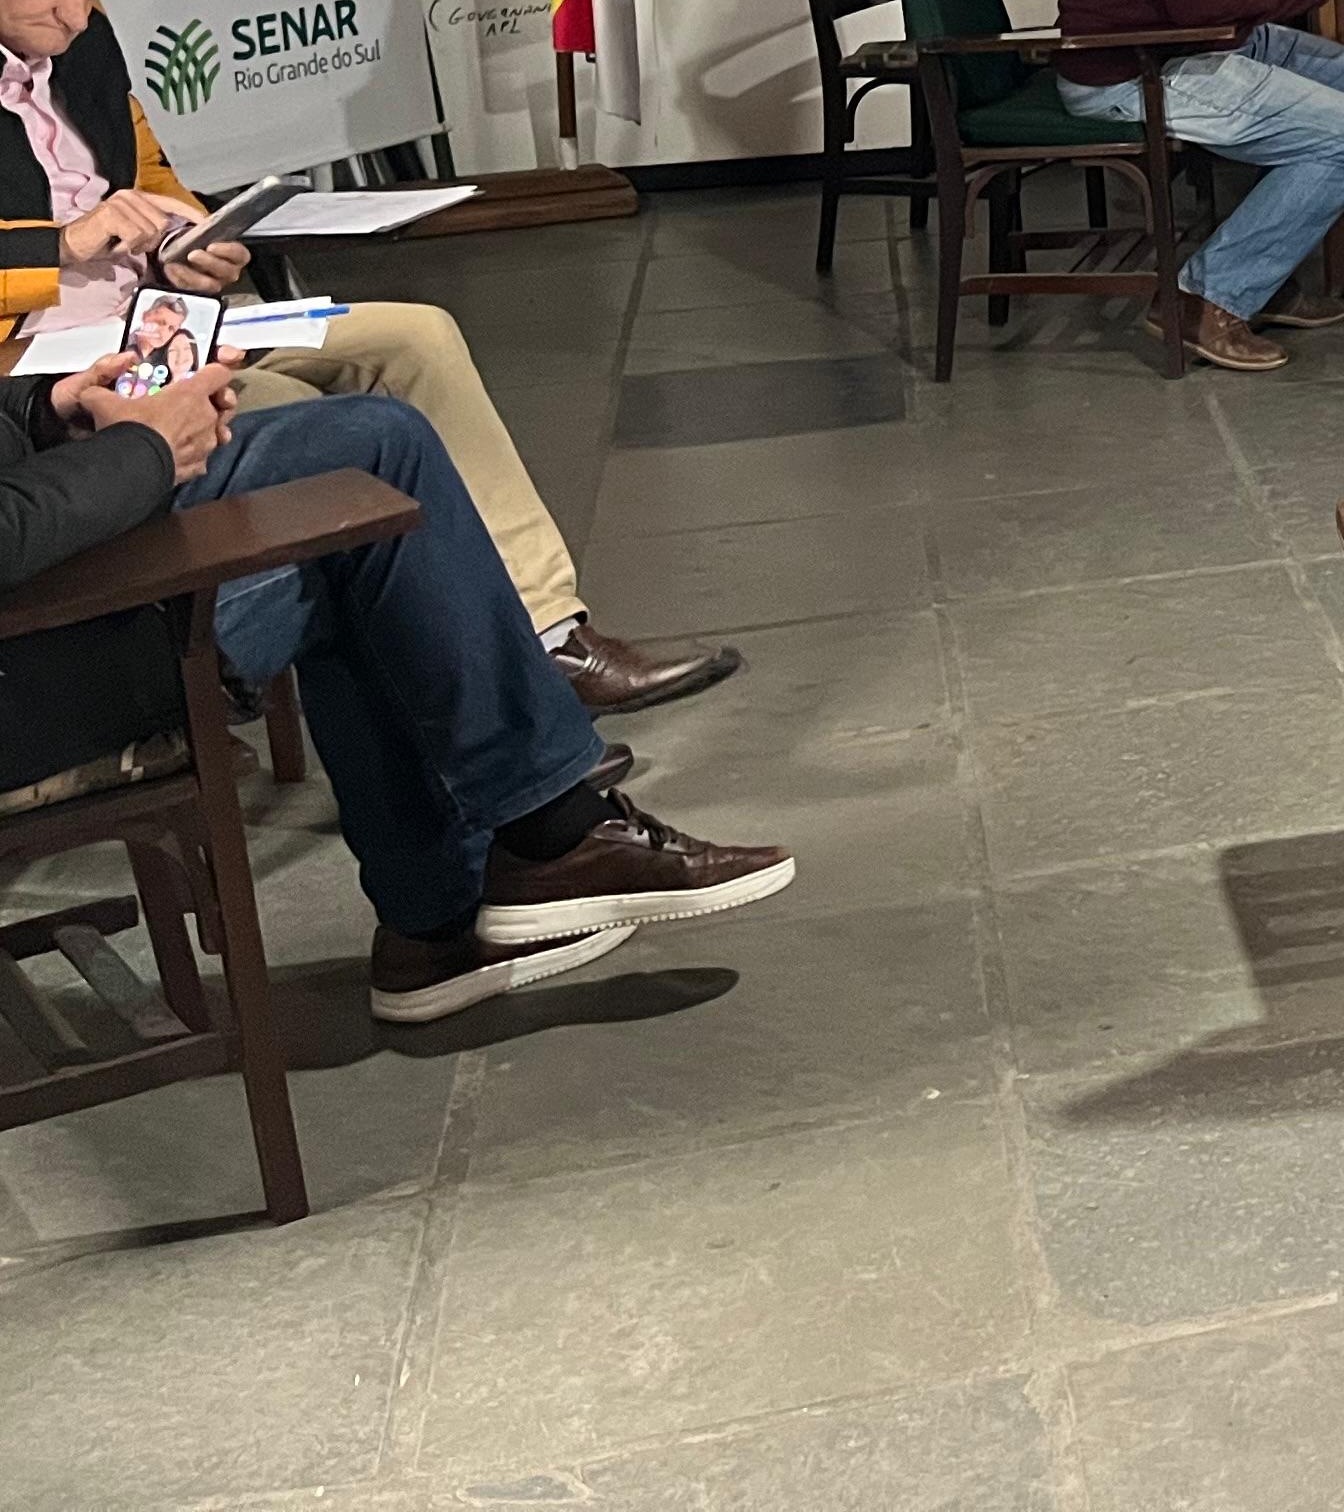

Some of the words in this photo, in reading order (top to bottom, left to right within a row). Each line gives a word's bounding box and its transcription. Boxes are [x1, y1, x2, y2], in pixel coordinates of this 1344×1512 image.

[234, 70, 264, 92] Rio
[266, 53, 328, 85] Grande
[331, 47, 353, 70] do
[354, 39, 381, 65] Sul
